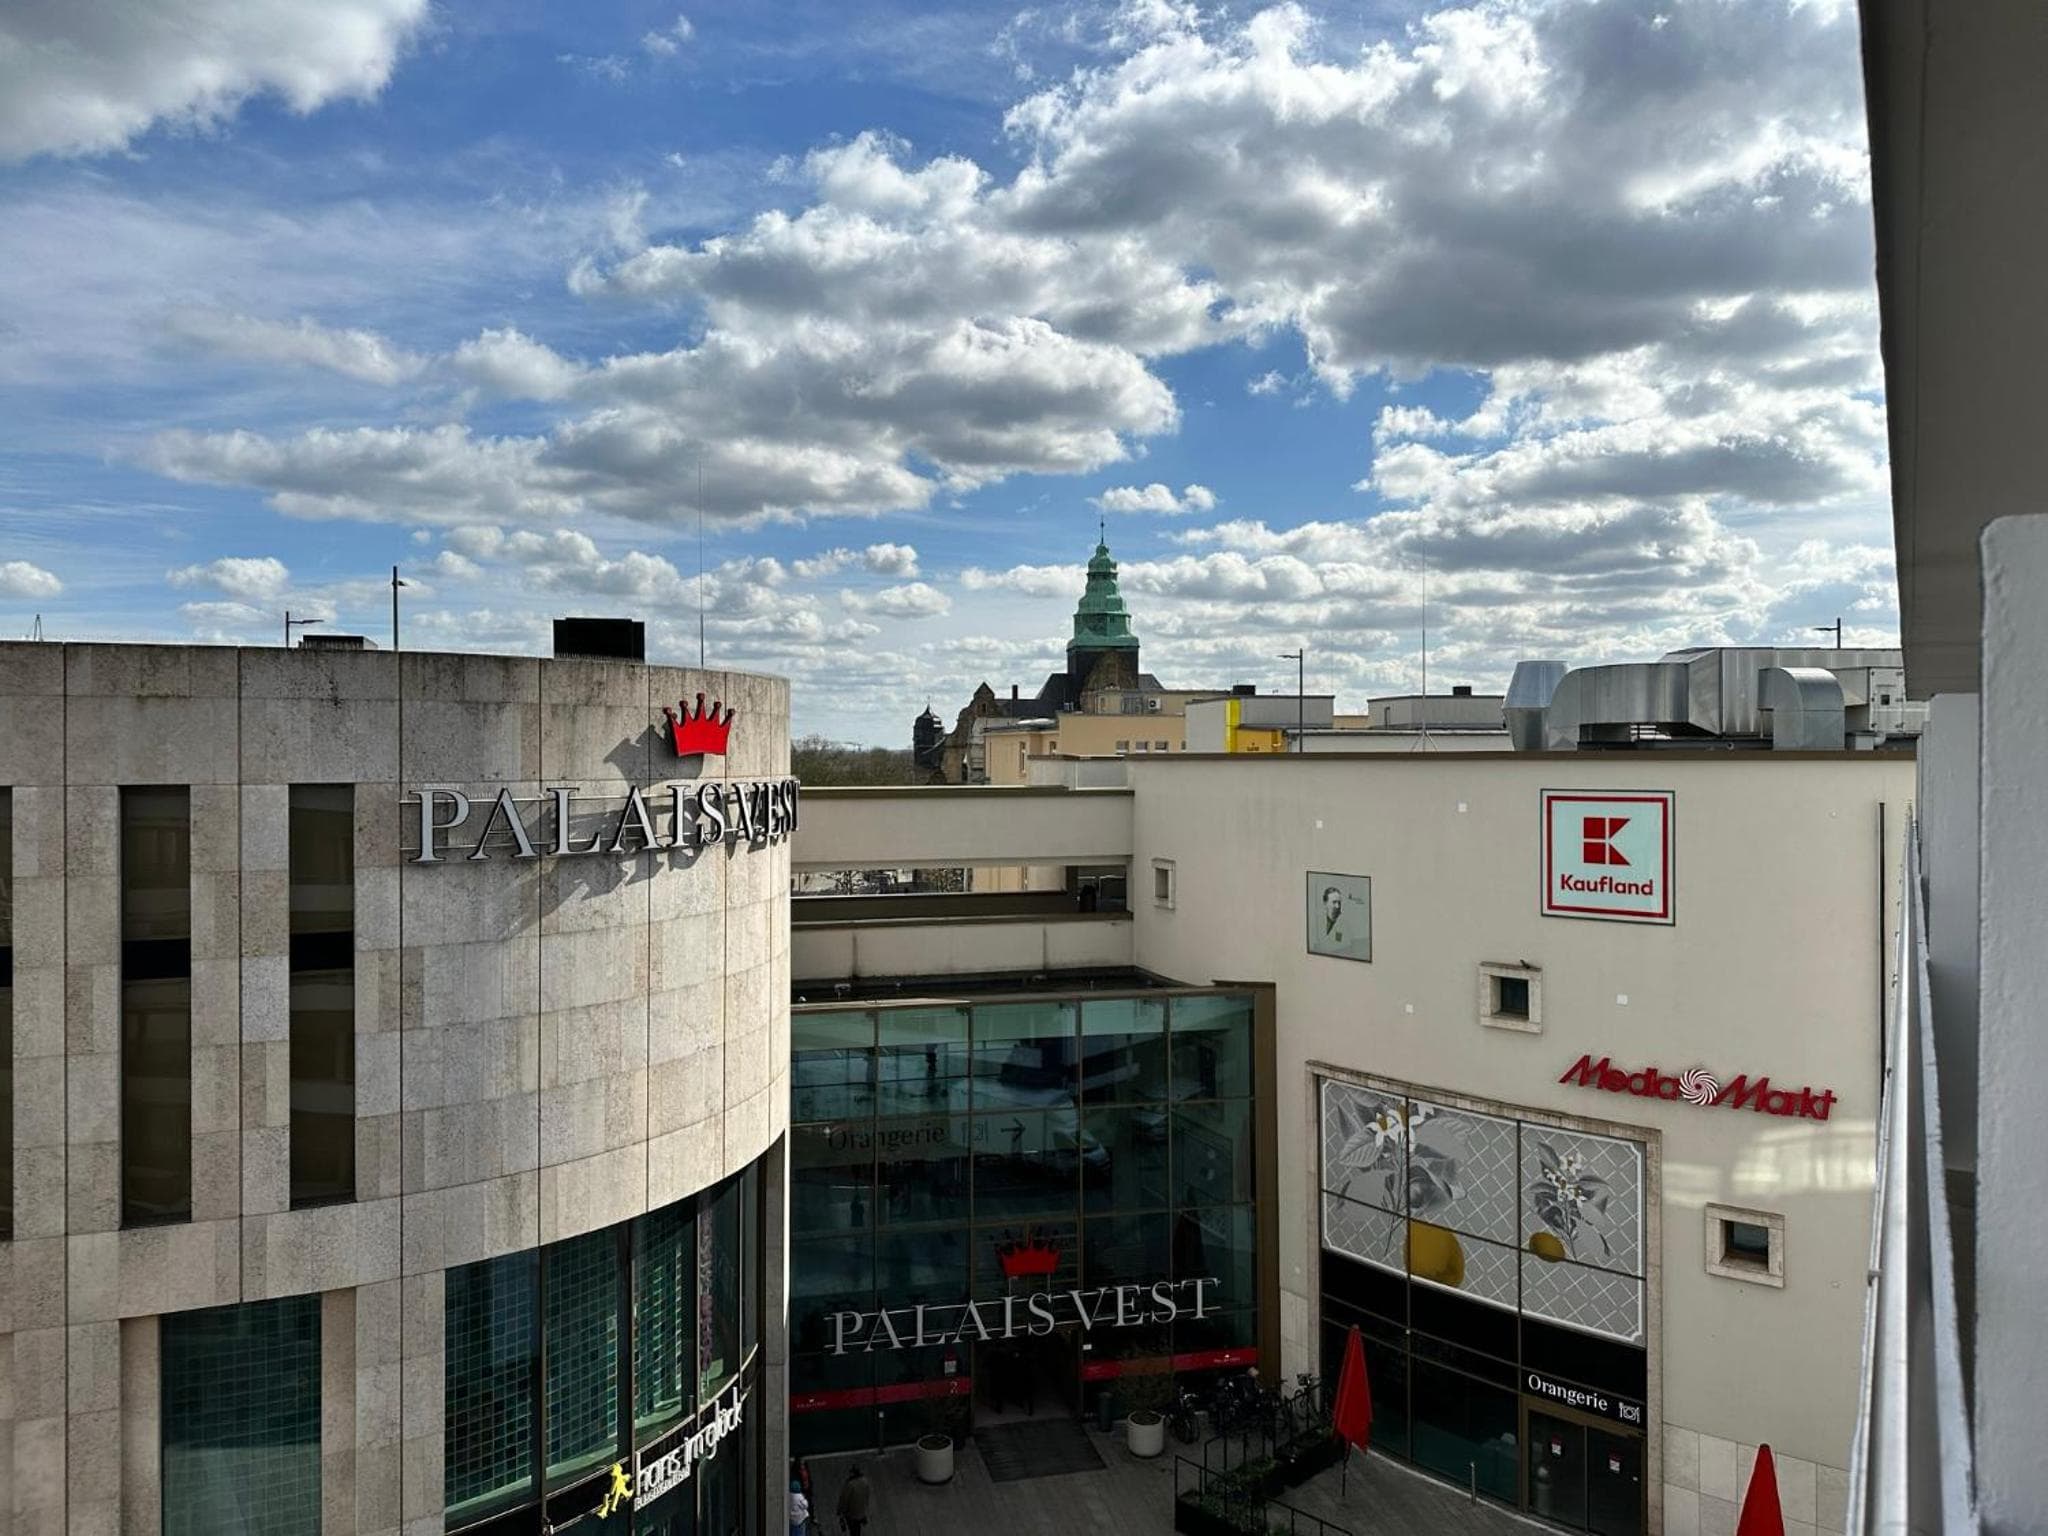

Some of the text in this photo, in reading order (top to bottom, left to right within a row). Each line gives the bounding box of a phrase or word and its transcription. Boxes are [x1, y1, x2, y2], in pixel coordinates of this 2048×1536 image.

[1560, 873, 1654, 896] Kaufland
[1558, 1055, 1838, 1121] Media Markt
[828, 1121, 946, 1152] Orangerie
[1528, 1374, 1608, 1412] Orangerie
[636, 1451, 681, 1497] hans
